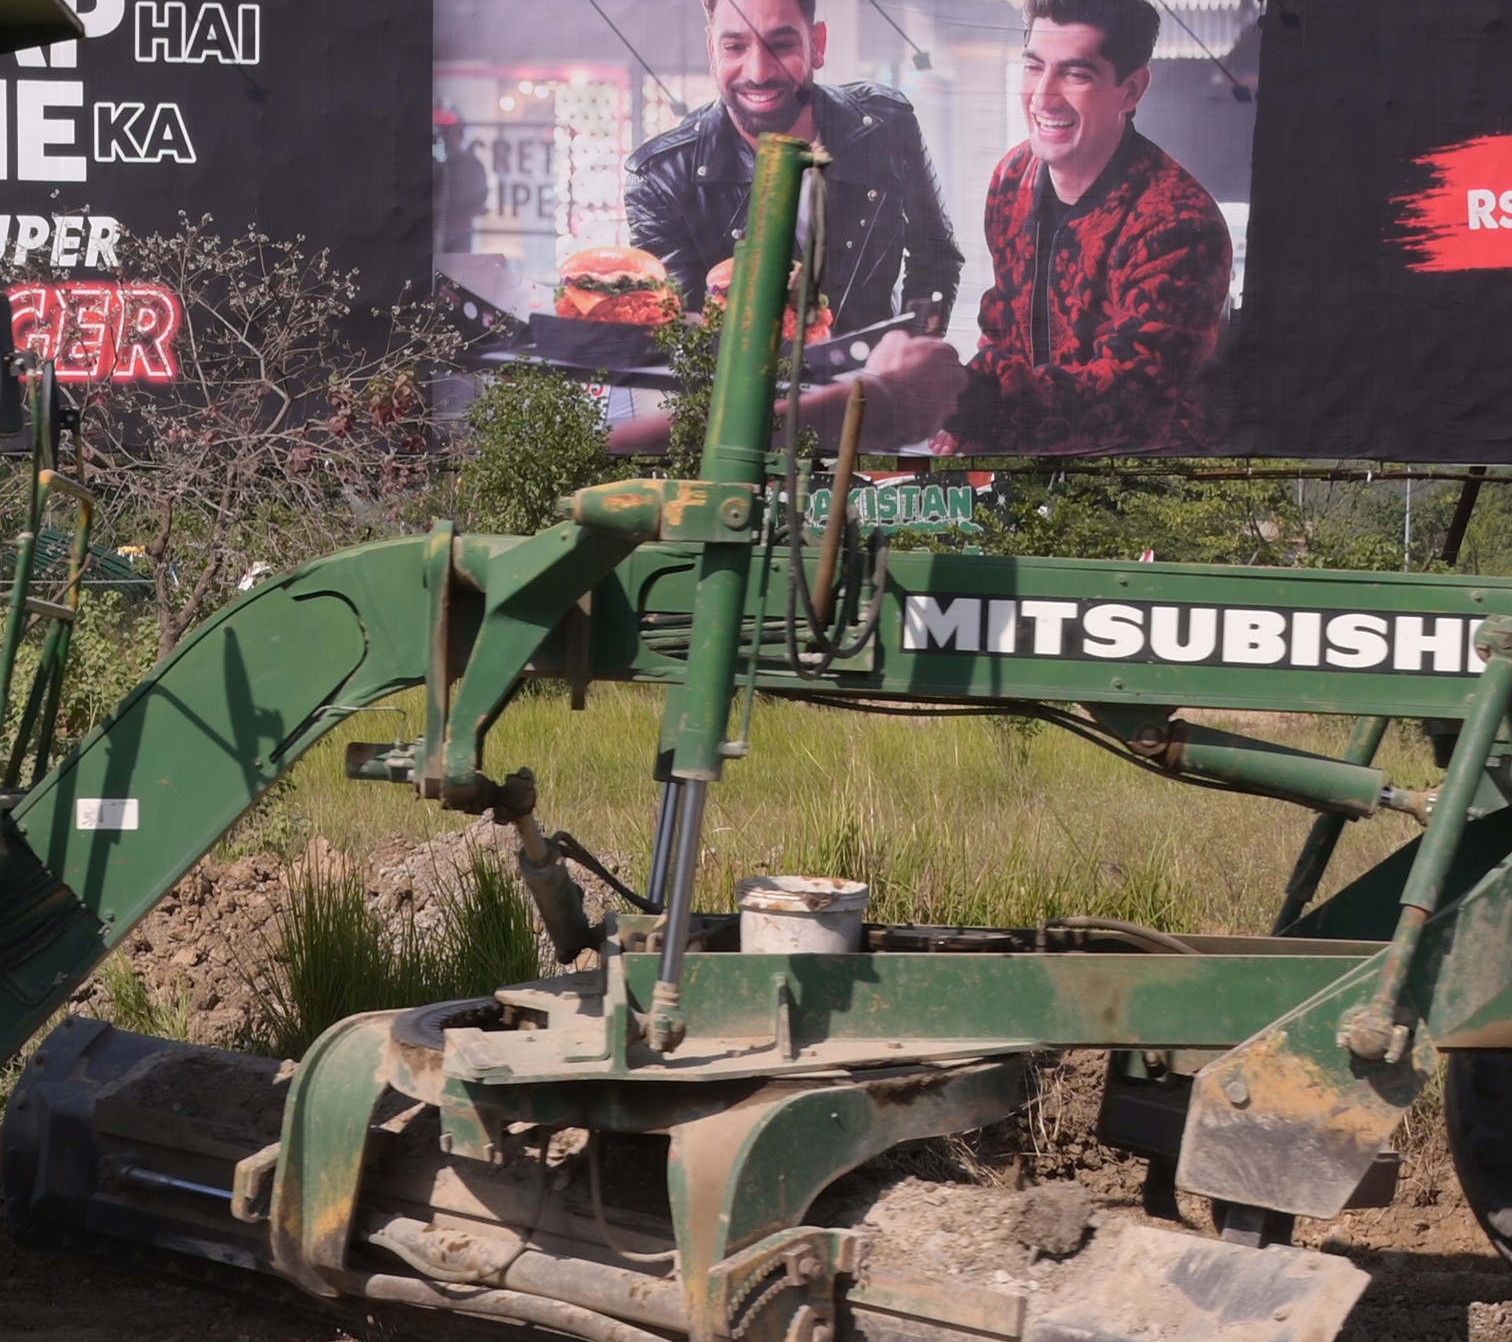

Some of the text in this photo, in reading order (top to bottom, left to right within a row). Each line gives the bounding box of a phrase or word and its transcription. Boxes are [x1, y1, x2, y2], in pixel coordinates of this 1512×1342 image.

[134, 0, 260, 64] HAI
[93, 101, 197, 163] KA
[805, 484, 974, 521] AISTAN
